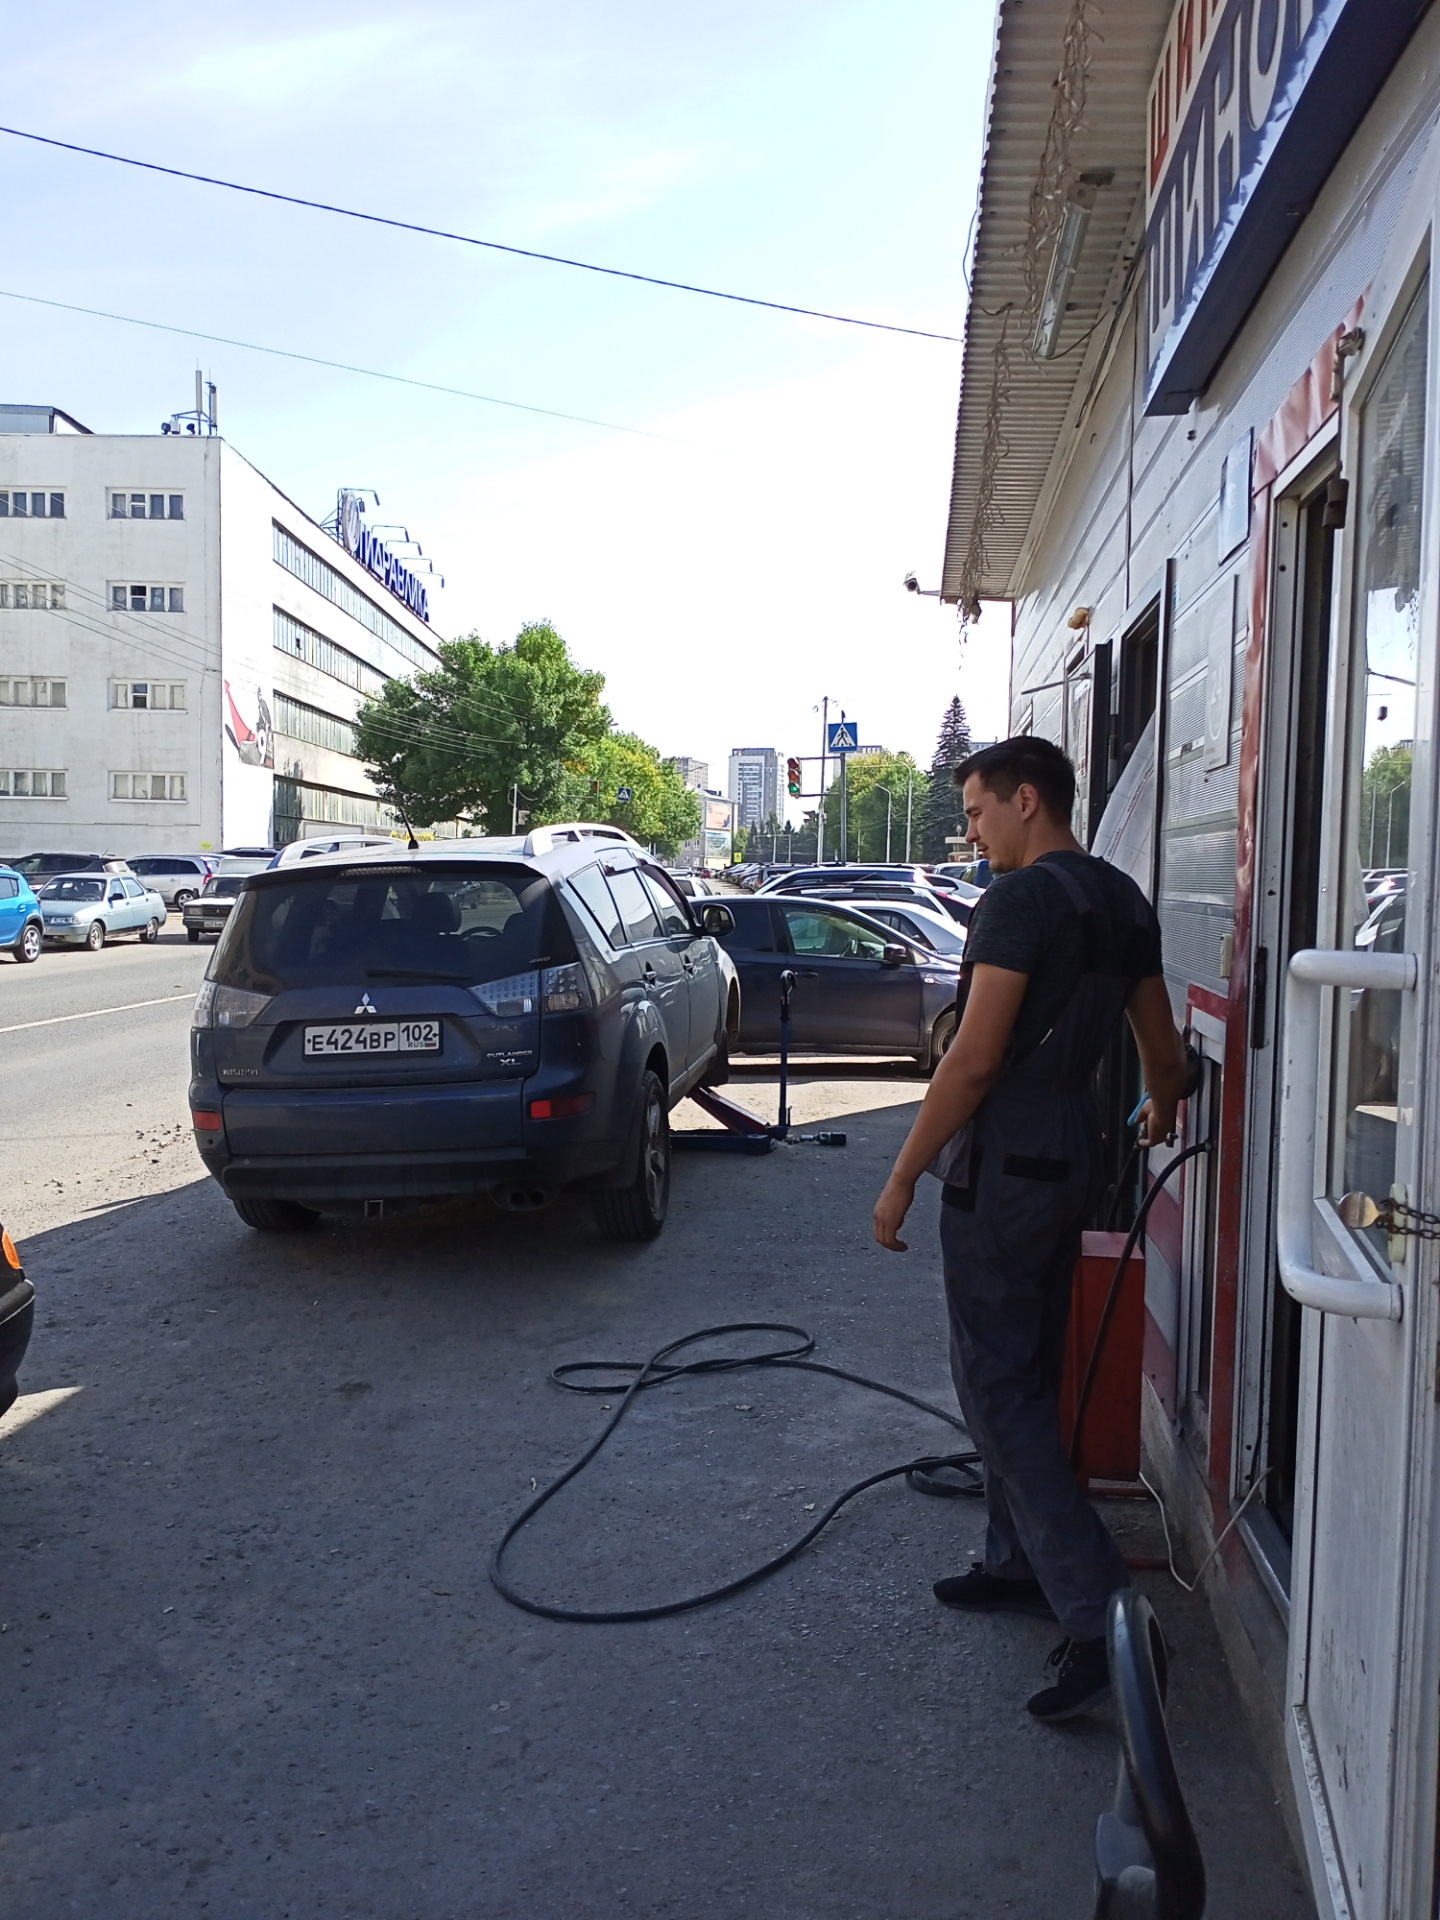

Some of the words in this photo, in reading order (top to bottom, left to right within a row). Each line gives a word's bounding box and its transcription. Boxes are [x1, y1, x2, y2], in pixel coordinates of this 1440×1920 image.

[1148, 0, 1313, 375] ШИНО
[401, 1024, 434, 1042] 102
[499, 1058, 522, 1066] XL
